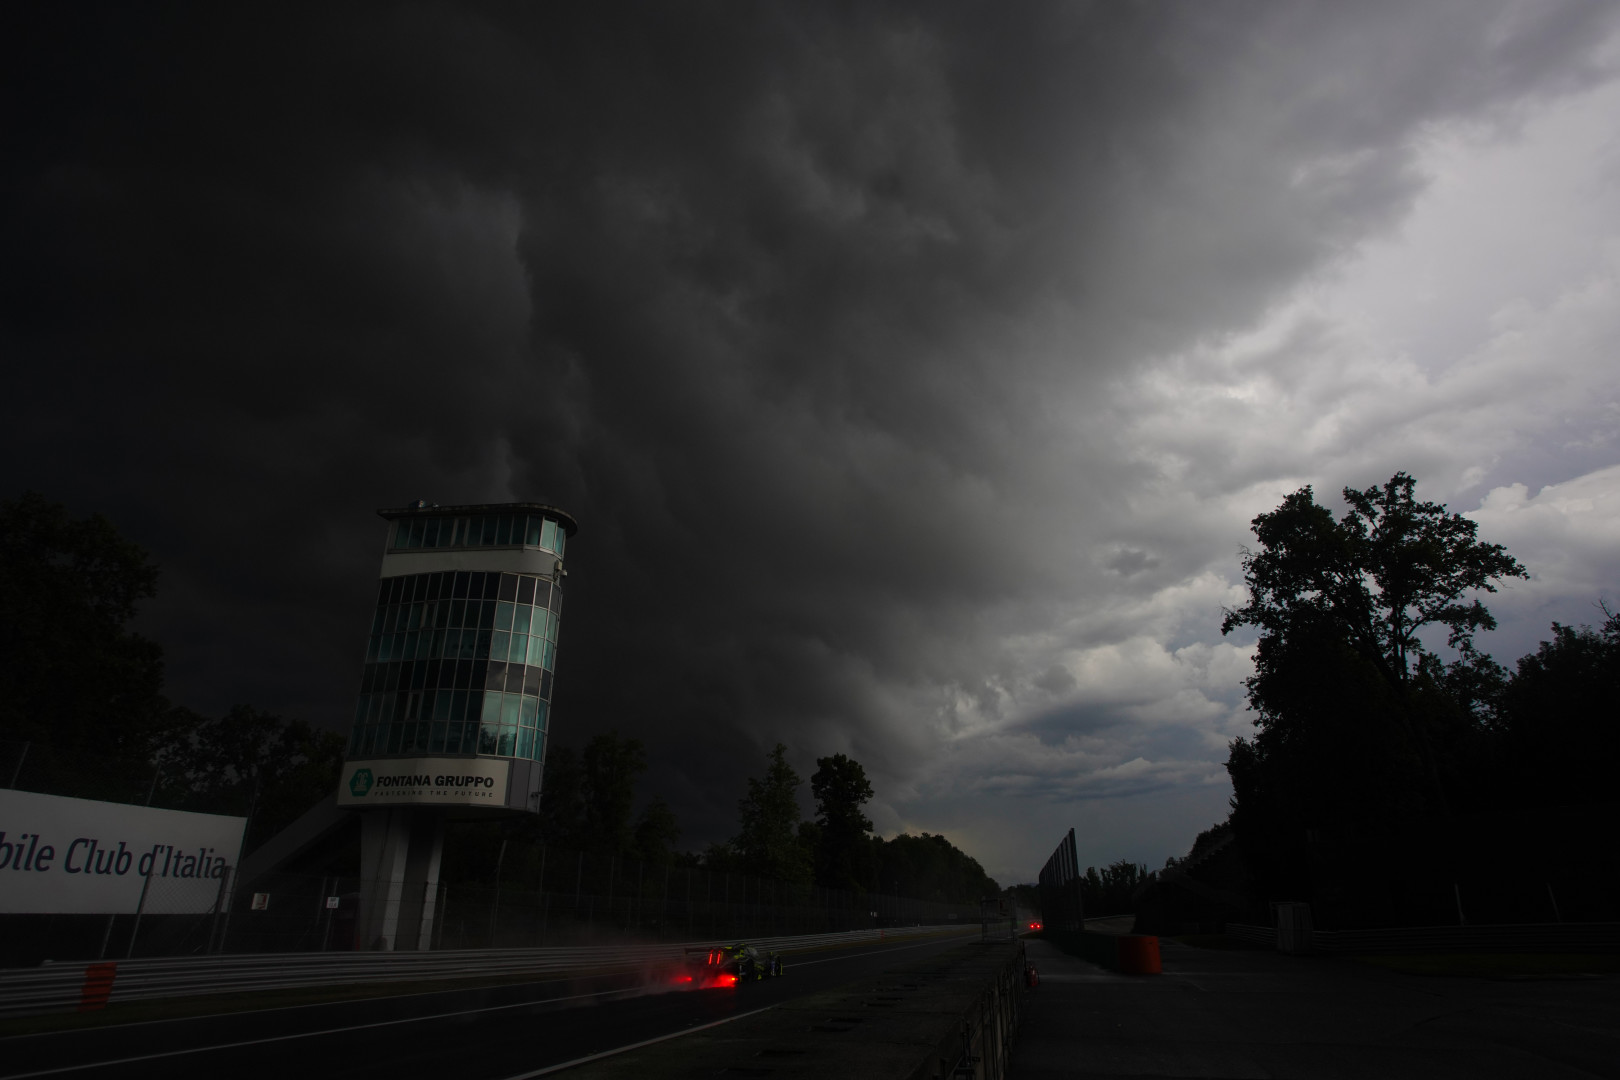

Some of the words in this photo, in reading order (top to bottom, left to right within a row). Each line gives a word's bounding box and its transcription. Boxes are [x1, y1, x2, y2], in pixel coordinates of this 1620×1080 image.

[376, 775, 431, 787] FONTANA
[434, 775, 494, 788] GRUPPO
[64, 837, 133, 876] Club
[138, 844, 227, 879] d'Italia
